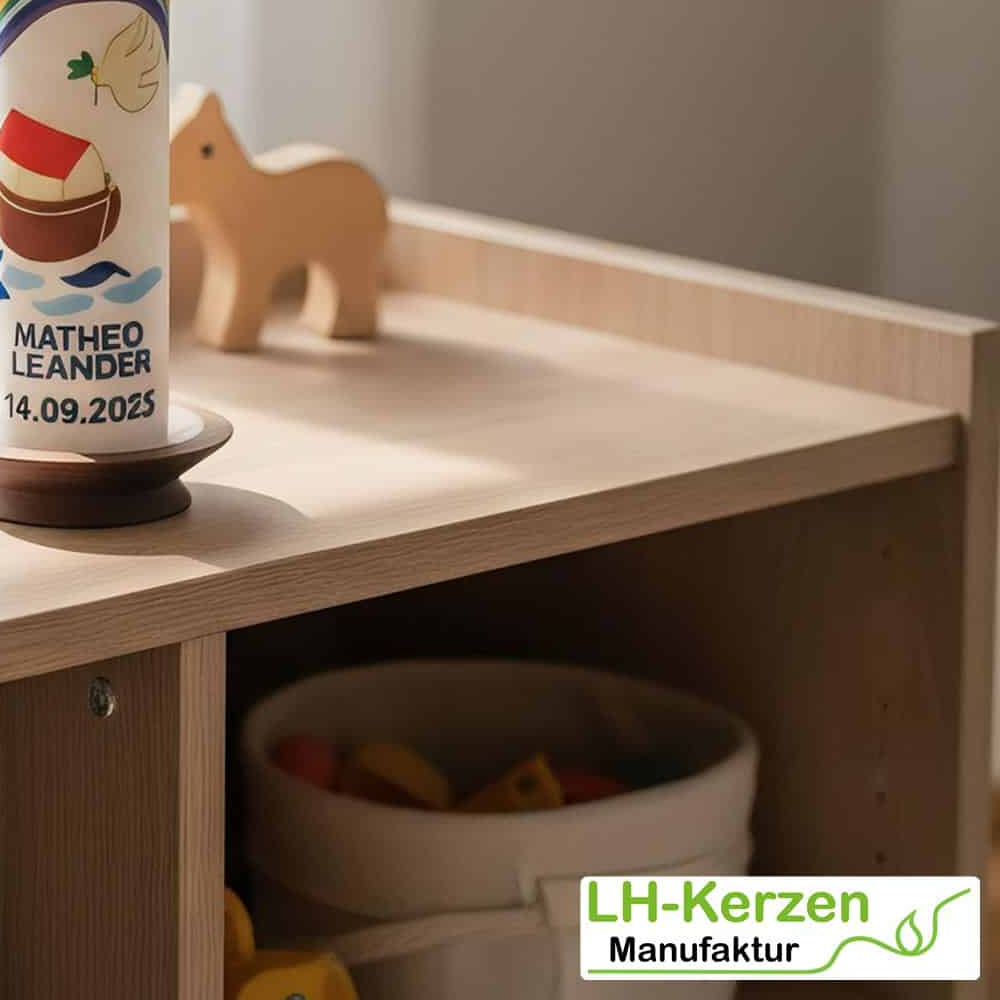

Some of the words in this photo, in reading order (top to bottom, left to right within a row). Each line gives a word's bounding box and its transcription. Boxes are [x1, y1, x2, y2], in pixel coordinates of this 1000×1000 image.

[14, 321, 143, 351] MATHEO
[12, 349, 151, 380] LEANDER
[4, 388, 156, 425] 14.09.2025
